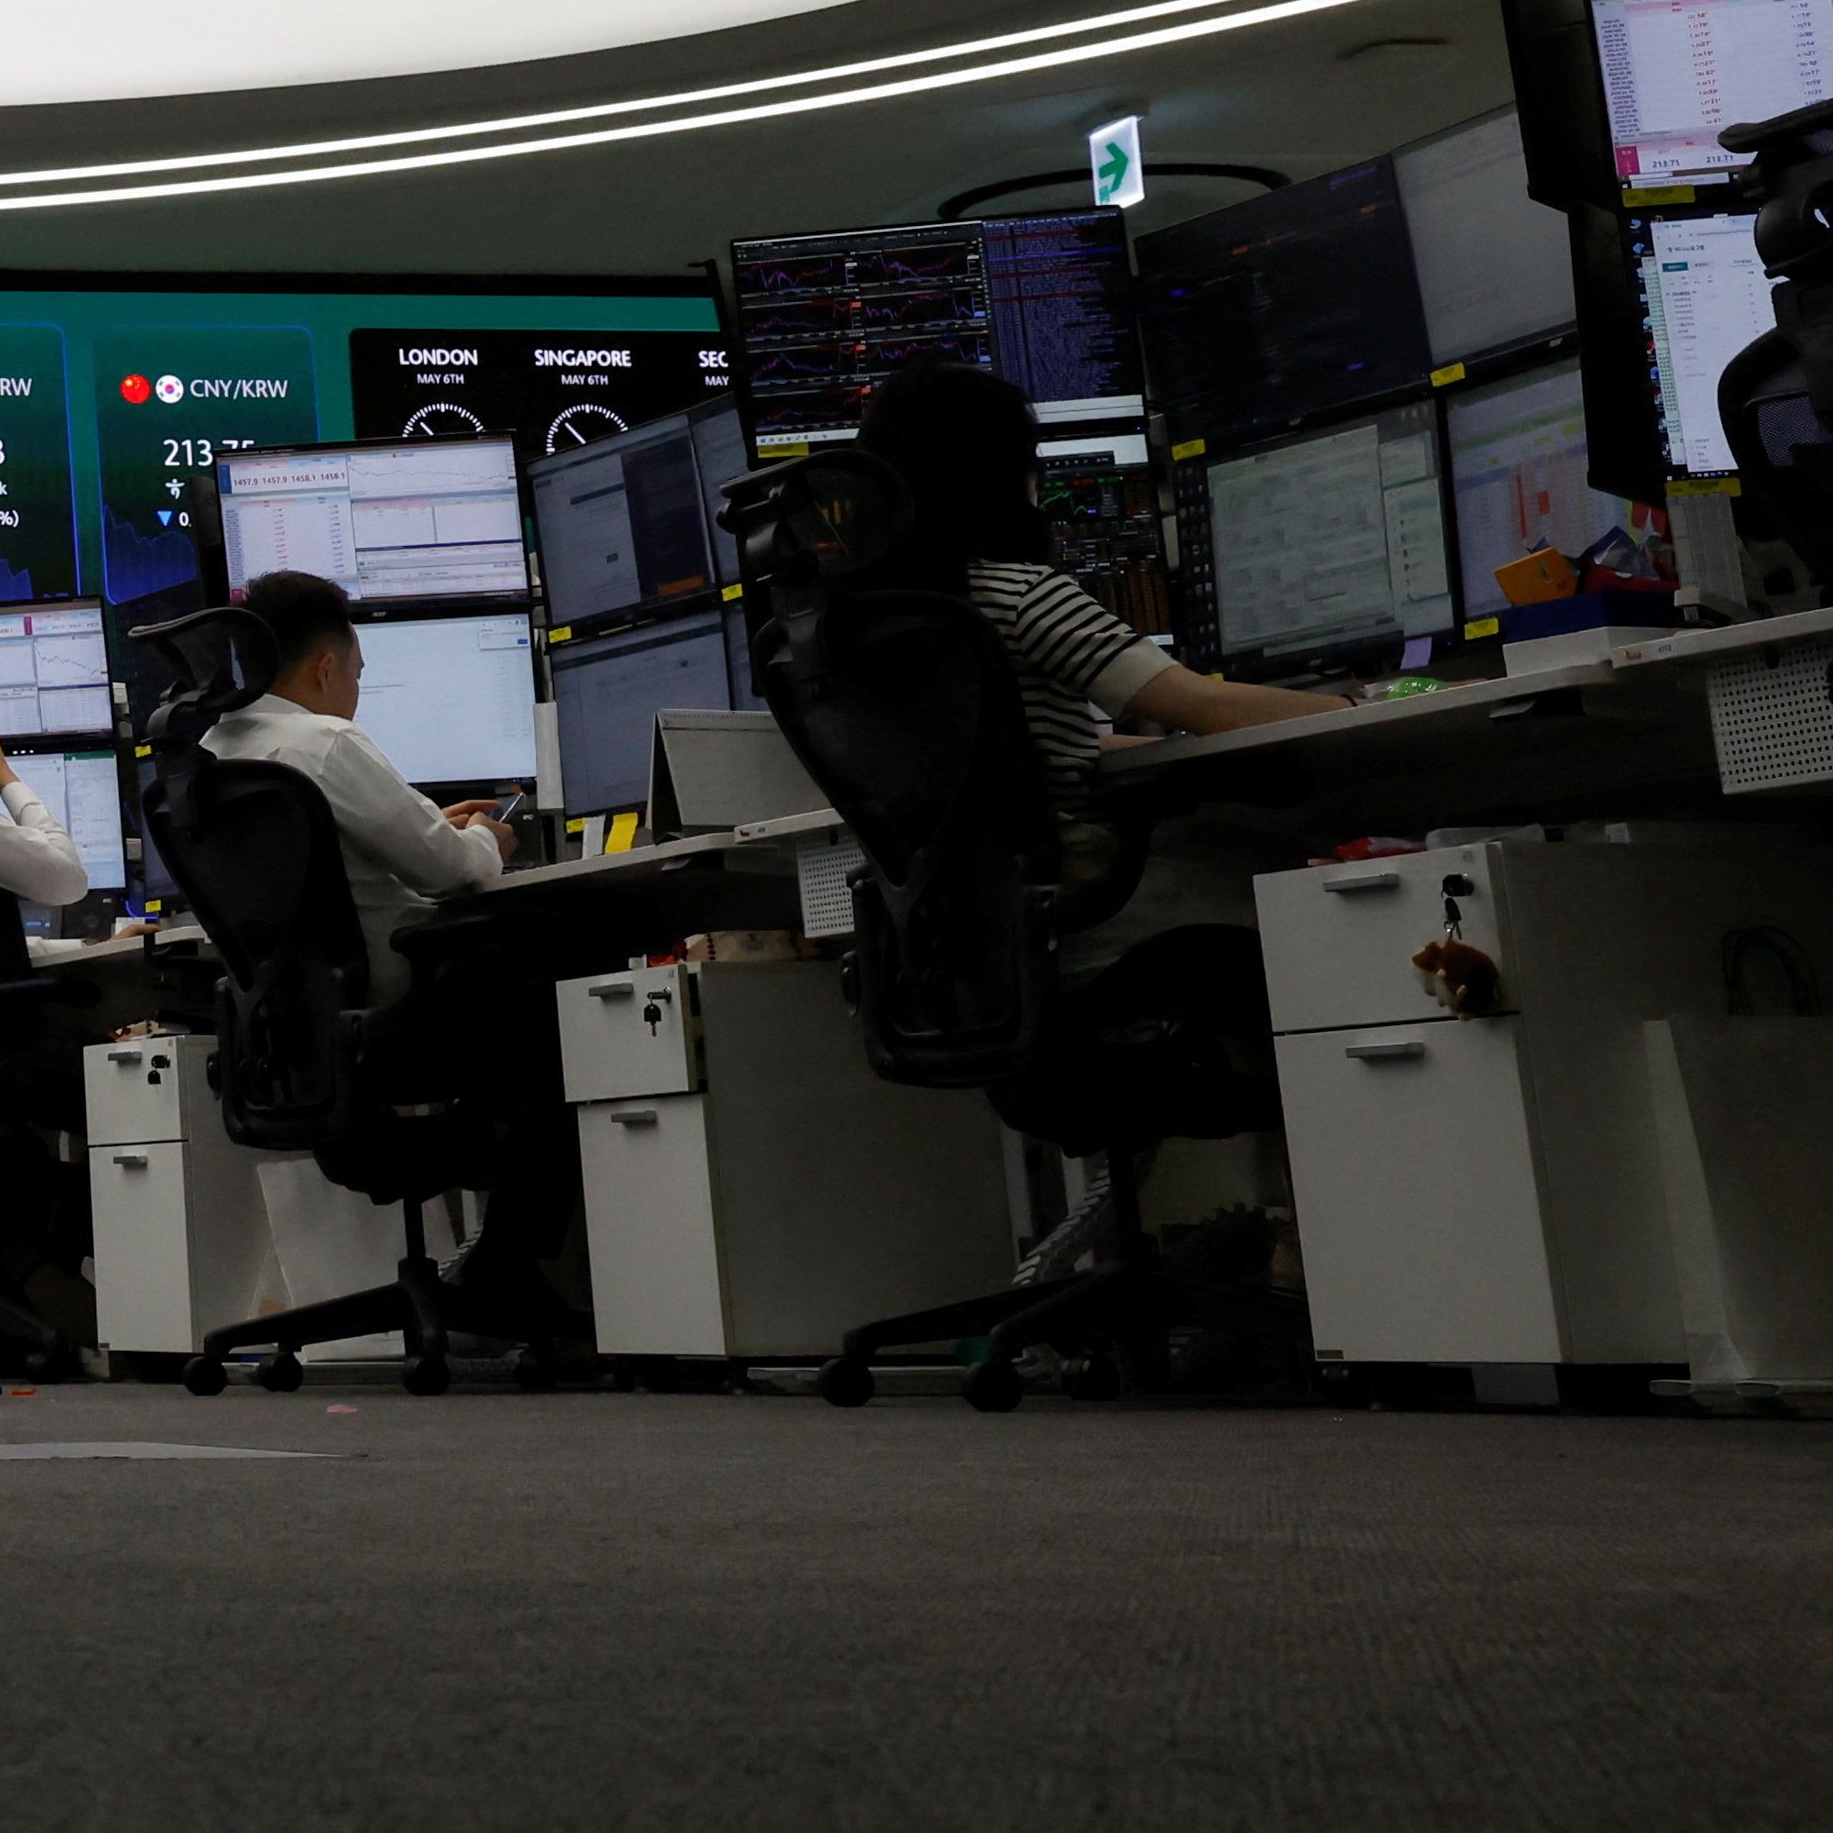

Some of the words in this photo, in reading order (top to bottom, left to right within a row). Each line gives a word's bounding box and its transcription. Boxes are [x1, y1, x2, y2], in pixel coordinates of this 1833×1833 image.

[398, 348, 479, 366] LONDON
[534, 349, 632, 367] SINGAPORE
[416, 373, 442, 384] MAY
[442, 373, 465, 385] 6TH
[561, 374, 586, 385] MAY
[587, 374, 609, 386] 6TH
[704, 375, 730, 386] MAY
[189, 379, 288, 400] CNY/KRW
[163, 438, 255, 467] 213
